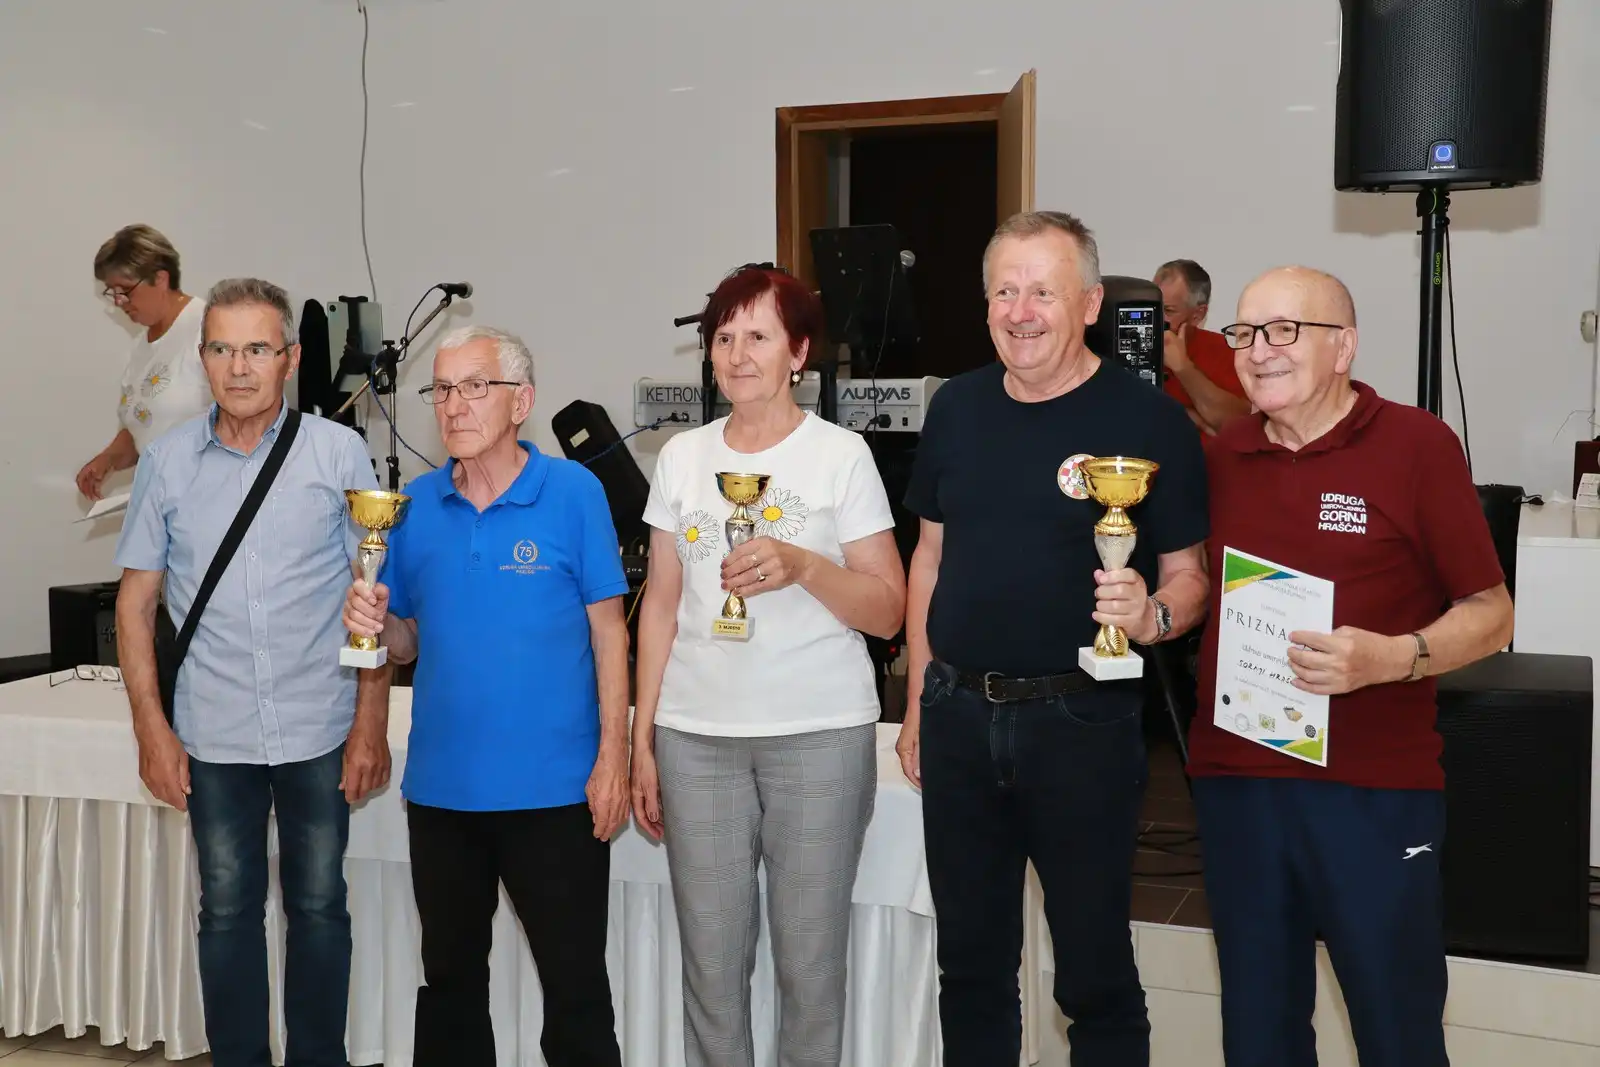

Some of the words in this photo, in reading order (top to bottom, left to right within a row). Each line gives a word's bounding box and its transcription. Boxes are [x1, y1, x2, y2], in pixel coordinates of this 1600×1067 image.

[646, 386, 703, 403] KETRON
[1320, 493, 1366, 506] UDRUGA
[1319, 510, 1367, 524] GORNJI
[519, 546, 532, 557] 75
[1226, 607, 1287, 641] PRIZNA
